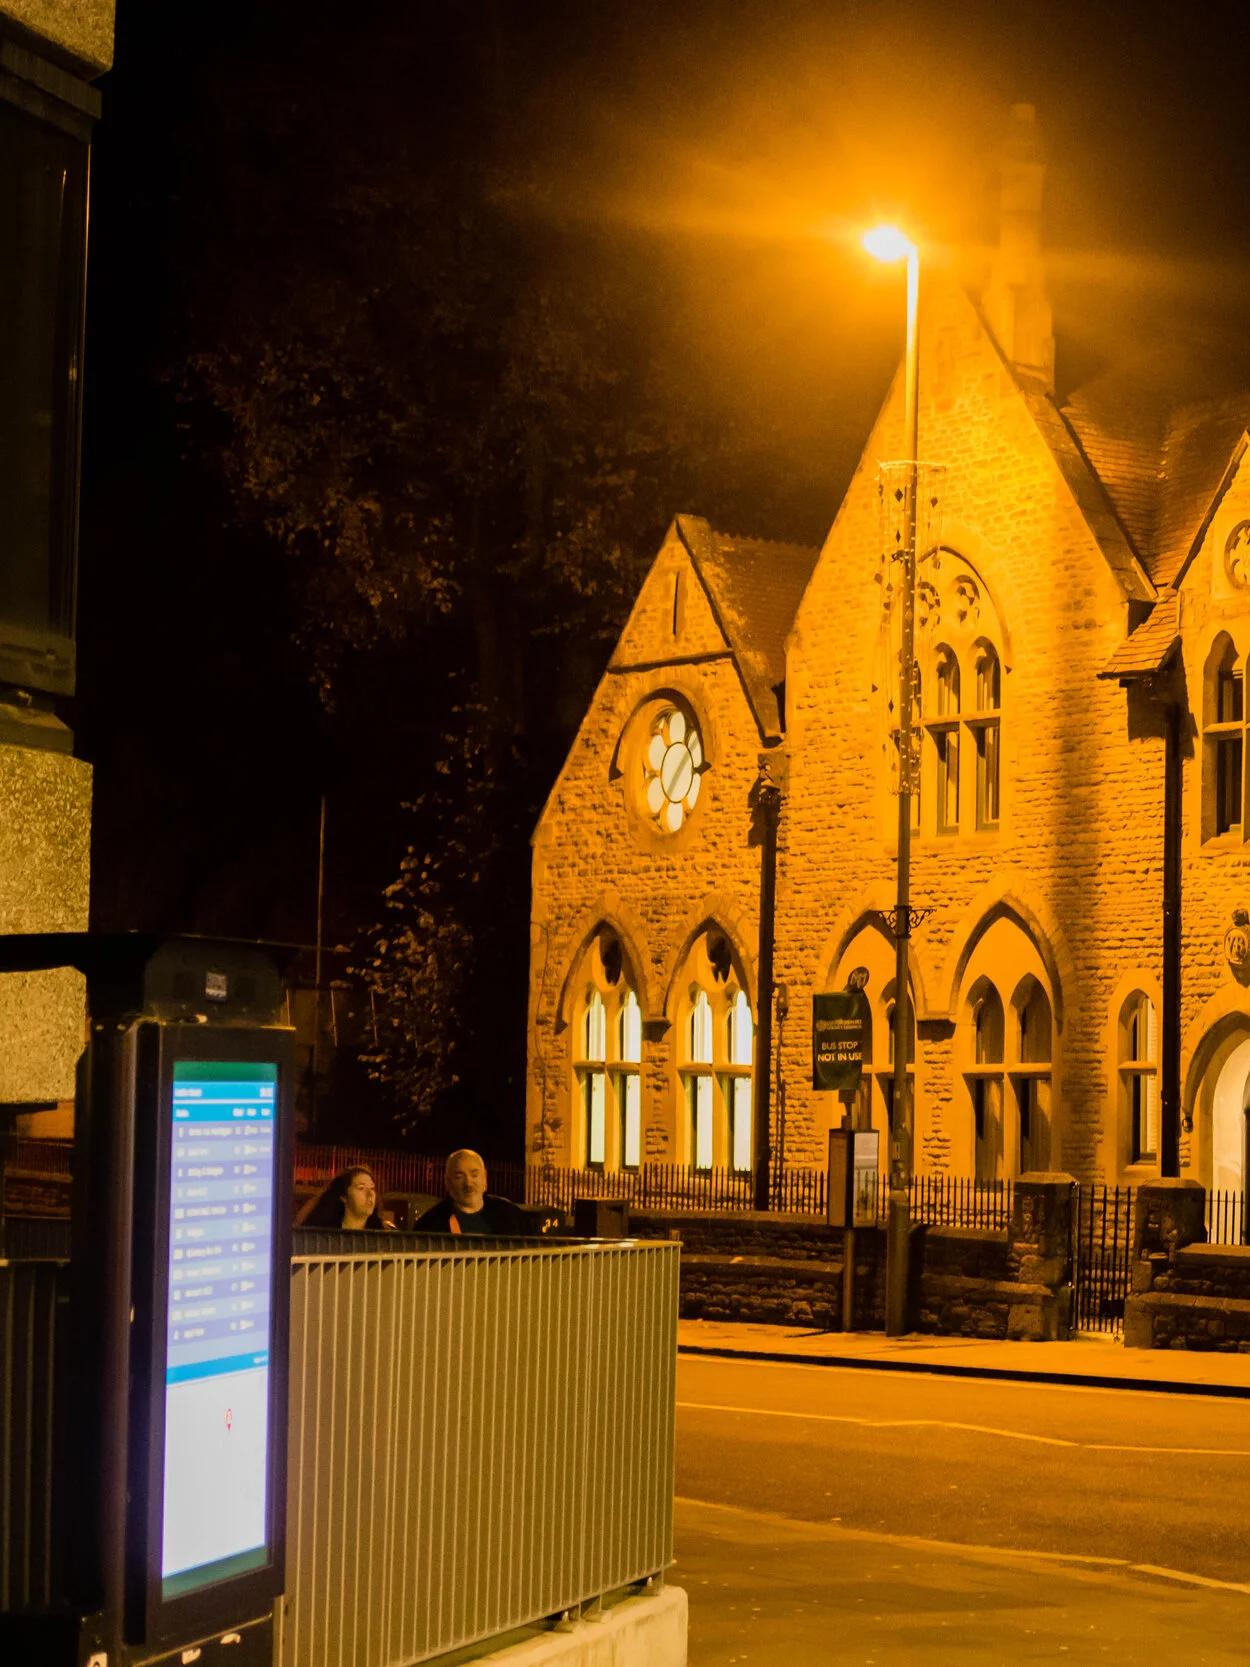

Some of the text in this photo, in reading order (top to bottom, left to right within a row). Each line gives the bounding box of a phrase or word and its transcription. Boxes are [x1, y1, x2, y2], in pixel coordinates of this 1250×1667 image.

[821, 1041, 858, 1050] BUS STOP
[817, 1052, 862, 1062] NOT IN USE
